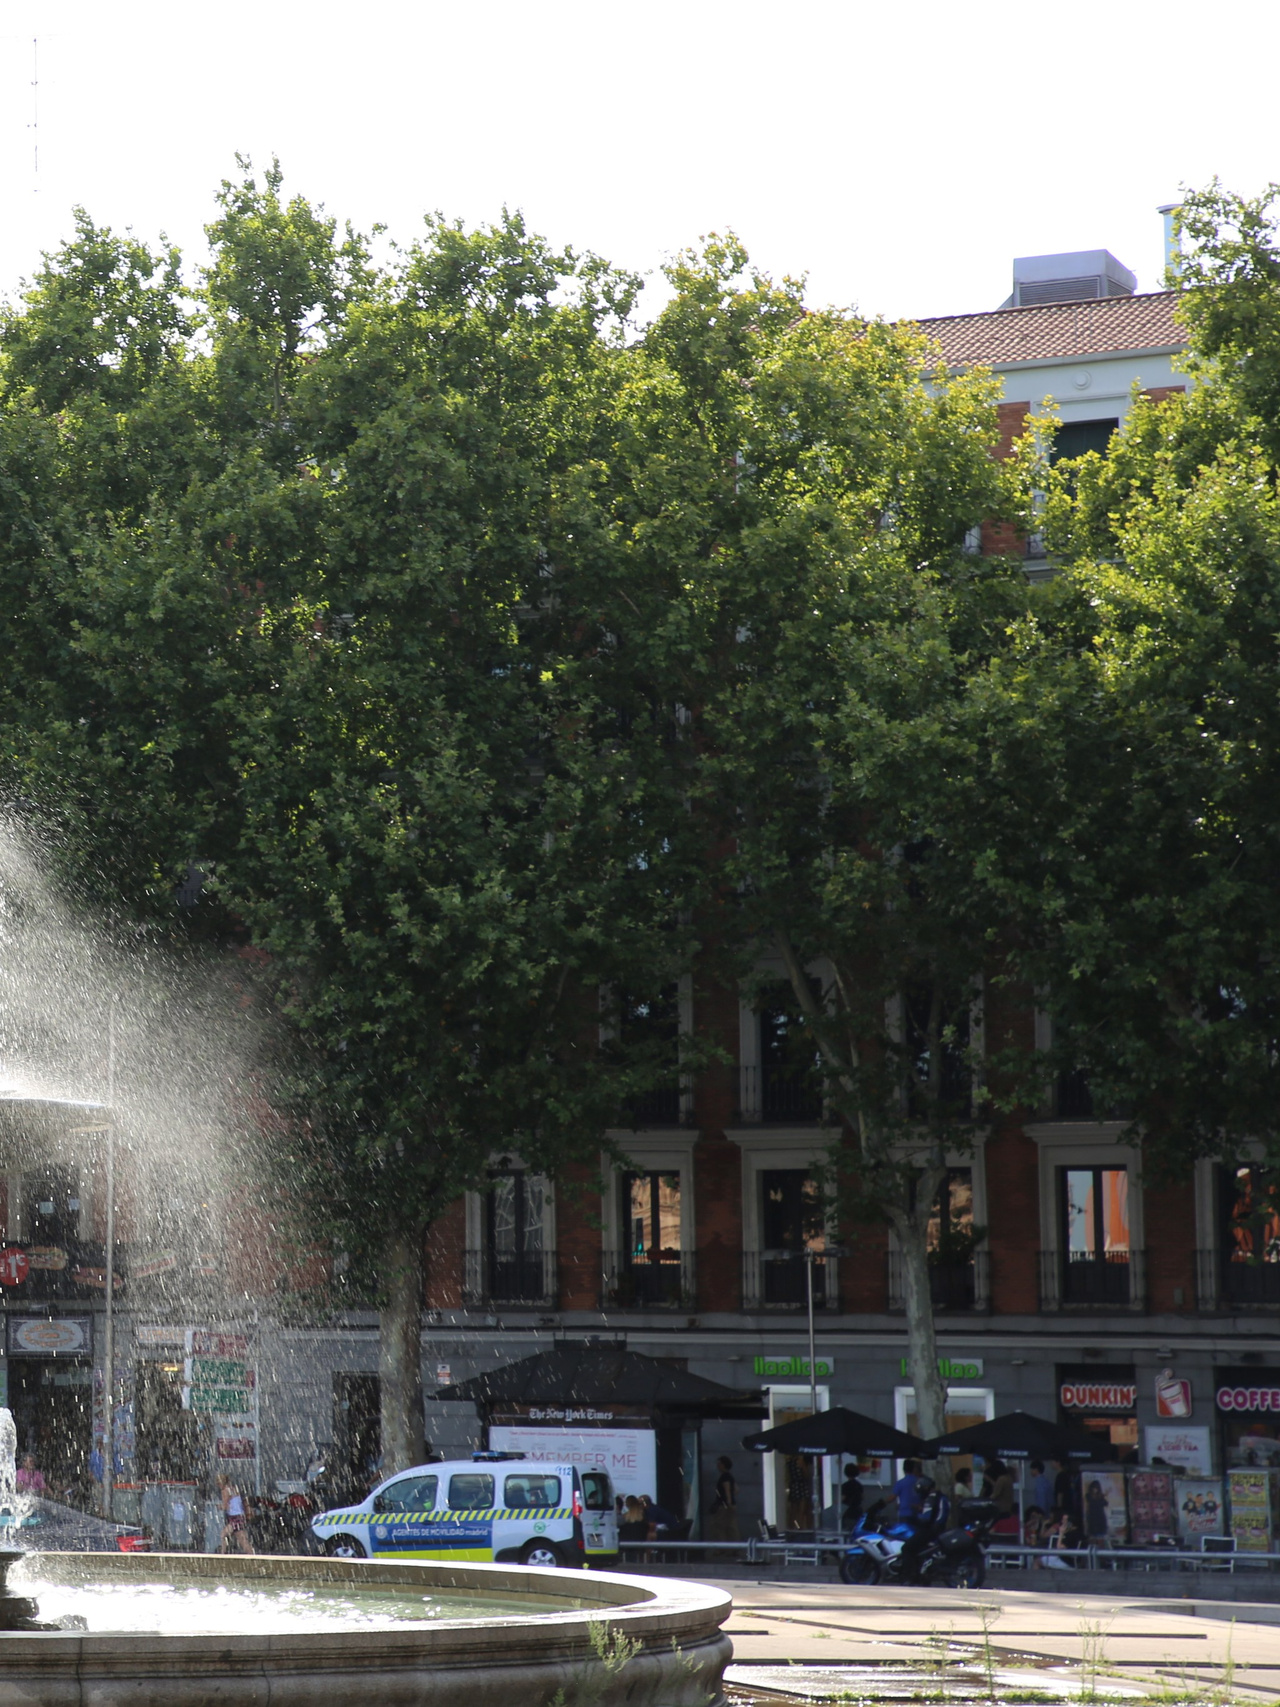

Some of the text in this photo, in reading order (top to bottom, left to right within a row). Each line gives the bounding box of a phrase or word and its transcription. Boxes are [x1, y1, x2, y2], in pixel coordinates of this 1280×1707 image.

[900, 1358, 978, 1378] lllao
[1061, 1384, 1137, 1408] DUNKIN'
[529, 1408, 613, 1422] The New York Times
[612, 1453, 637, 1468] ME
[558, 1466, 571, 1476] 112
[392, 1528, 488, 1537] AGENTES DE MOVILIDAD madrid
